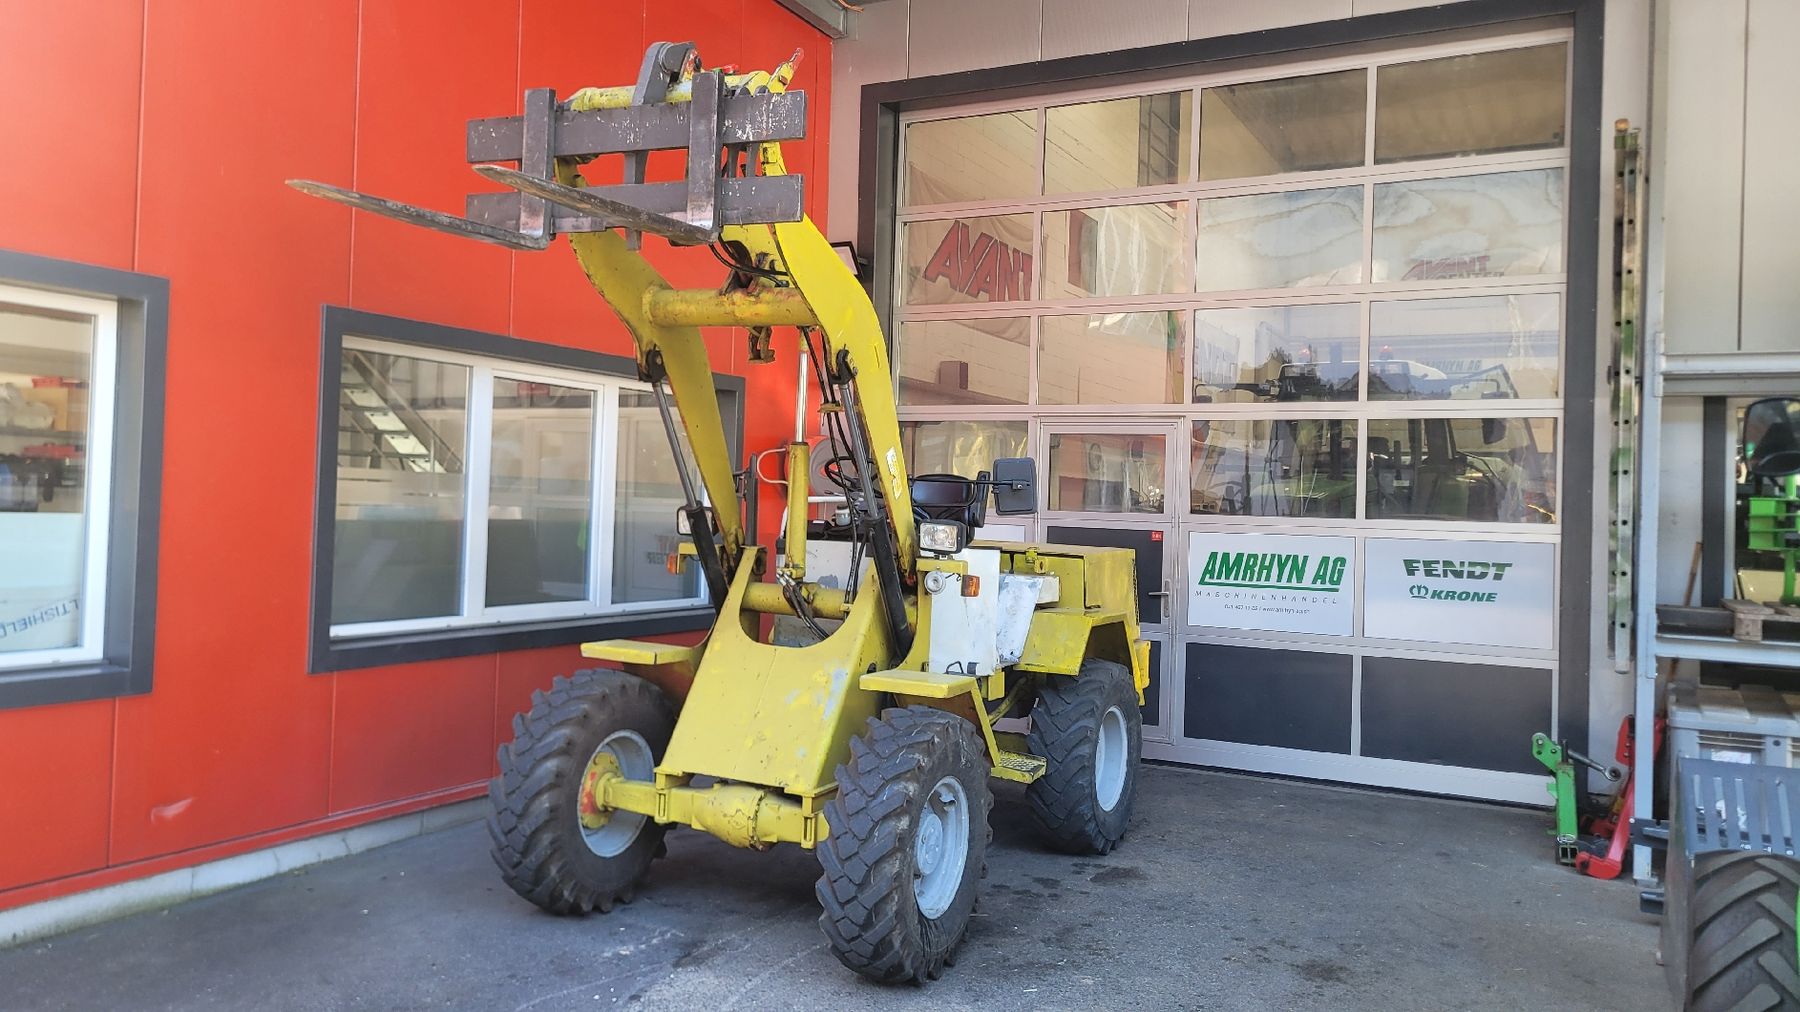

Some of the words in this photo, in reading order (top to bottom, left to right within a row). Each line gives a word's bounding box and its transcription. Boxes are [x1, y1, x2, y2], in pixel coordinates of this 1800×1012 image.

[1199, 551, 1309, 585] AMRHYN
[1311, 556, 1347, 585] AG
[1403, 559, 1513, 581] FENDT
[1430, 589, 1498, 602] KRONE
